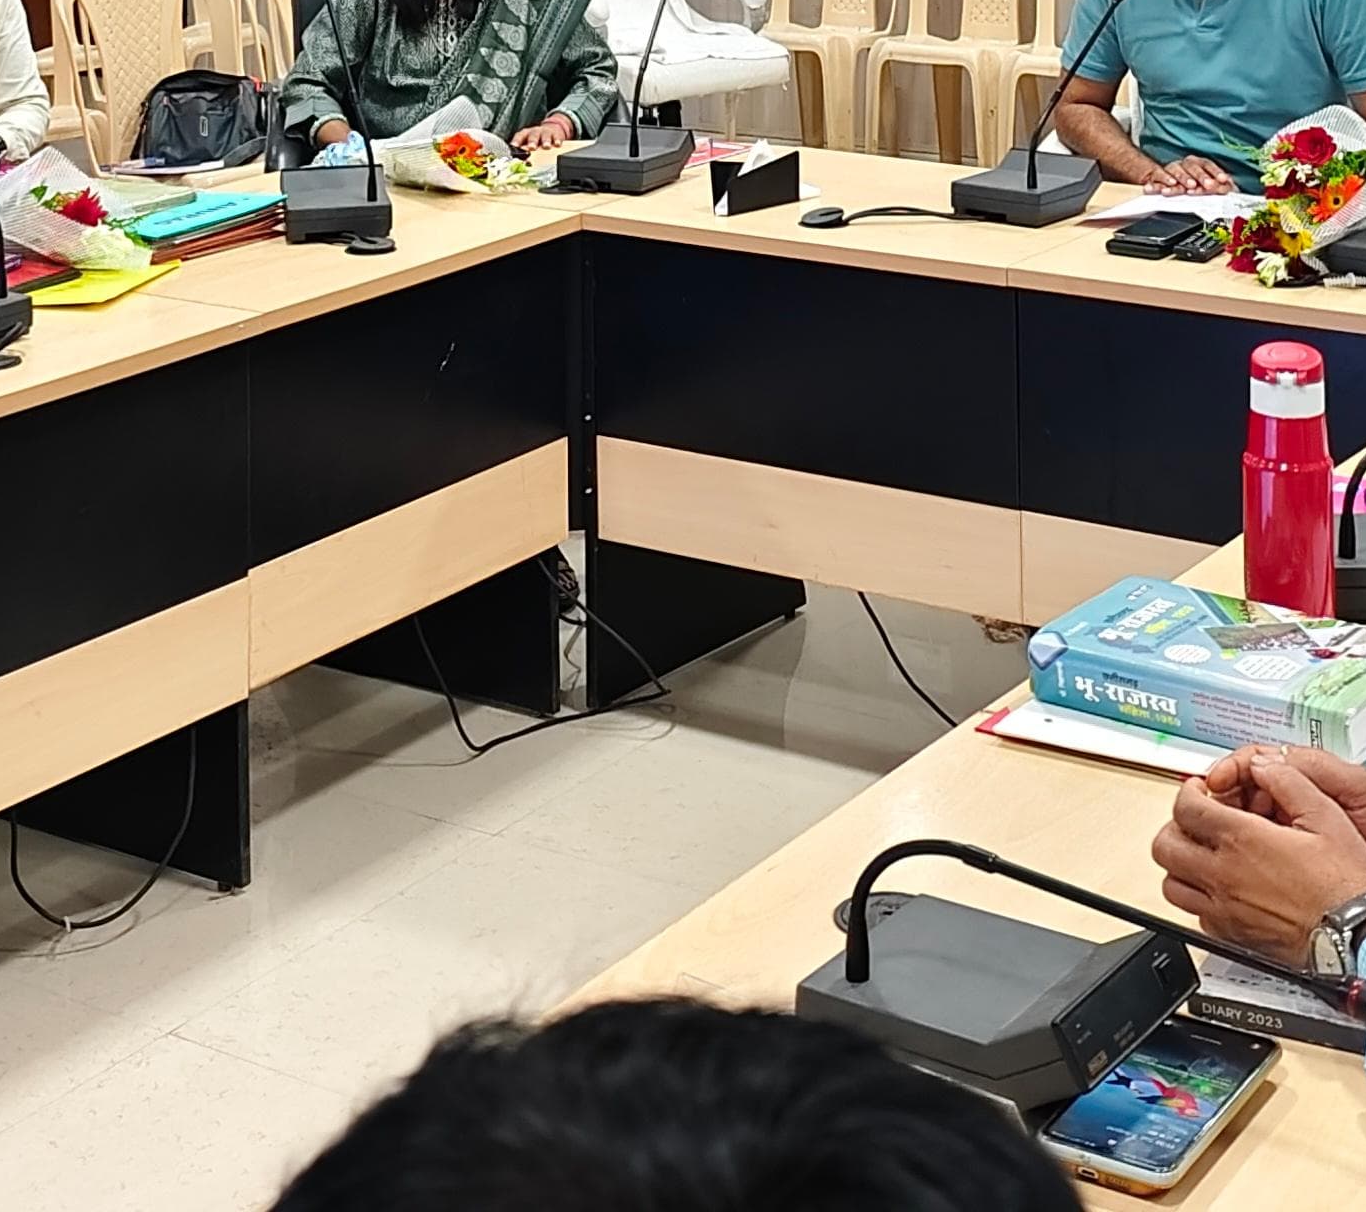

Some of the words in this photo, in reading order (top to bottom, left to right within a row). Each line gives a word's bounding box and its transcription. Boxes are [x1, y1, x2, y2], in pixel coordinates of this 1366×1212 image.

[1075, 675, 1179, 715] भू-राजस्व
[1202, 1002, 1242, 1020] DIARY
[1247, 1011, 1283, 1029] 2023
